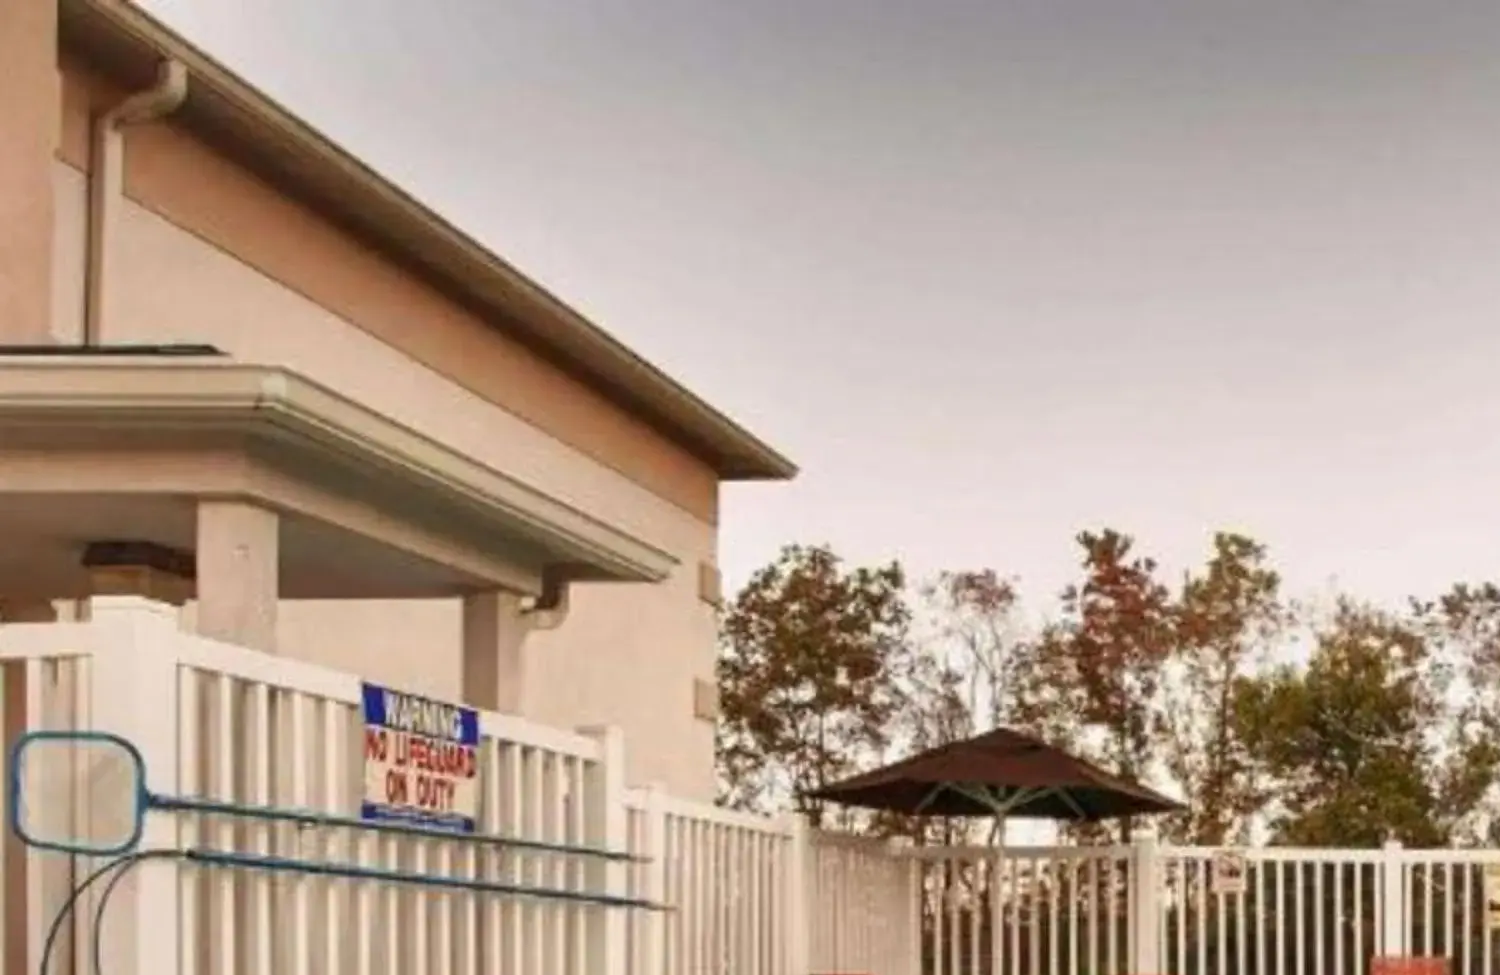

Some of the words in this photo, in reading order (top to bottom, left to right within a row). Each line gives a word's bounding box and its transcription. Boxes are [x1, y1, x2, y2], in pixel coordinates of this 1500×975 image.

[384, 693, 462, 741] WARNING
[364, 727, 388, 761] NO
[396, 733, 476, 779] LIFEGUARD
[386, 768, 408, 803] ON
[417, 774, 455, 811] DUTY
